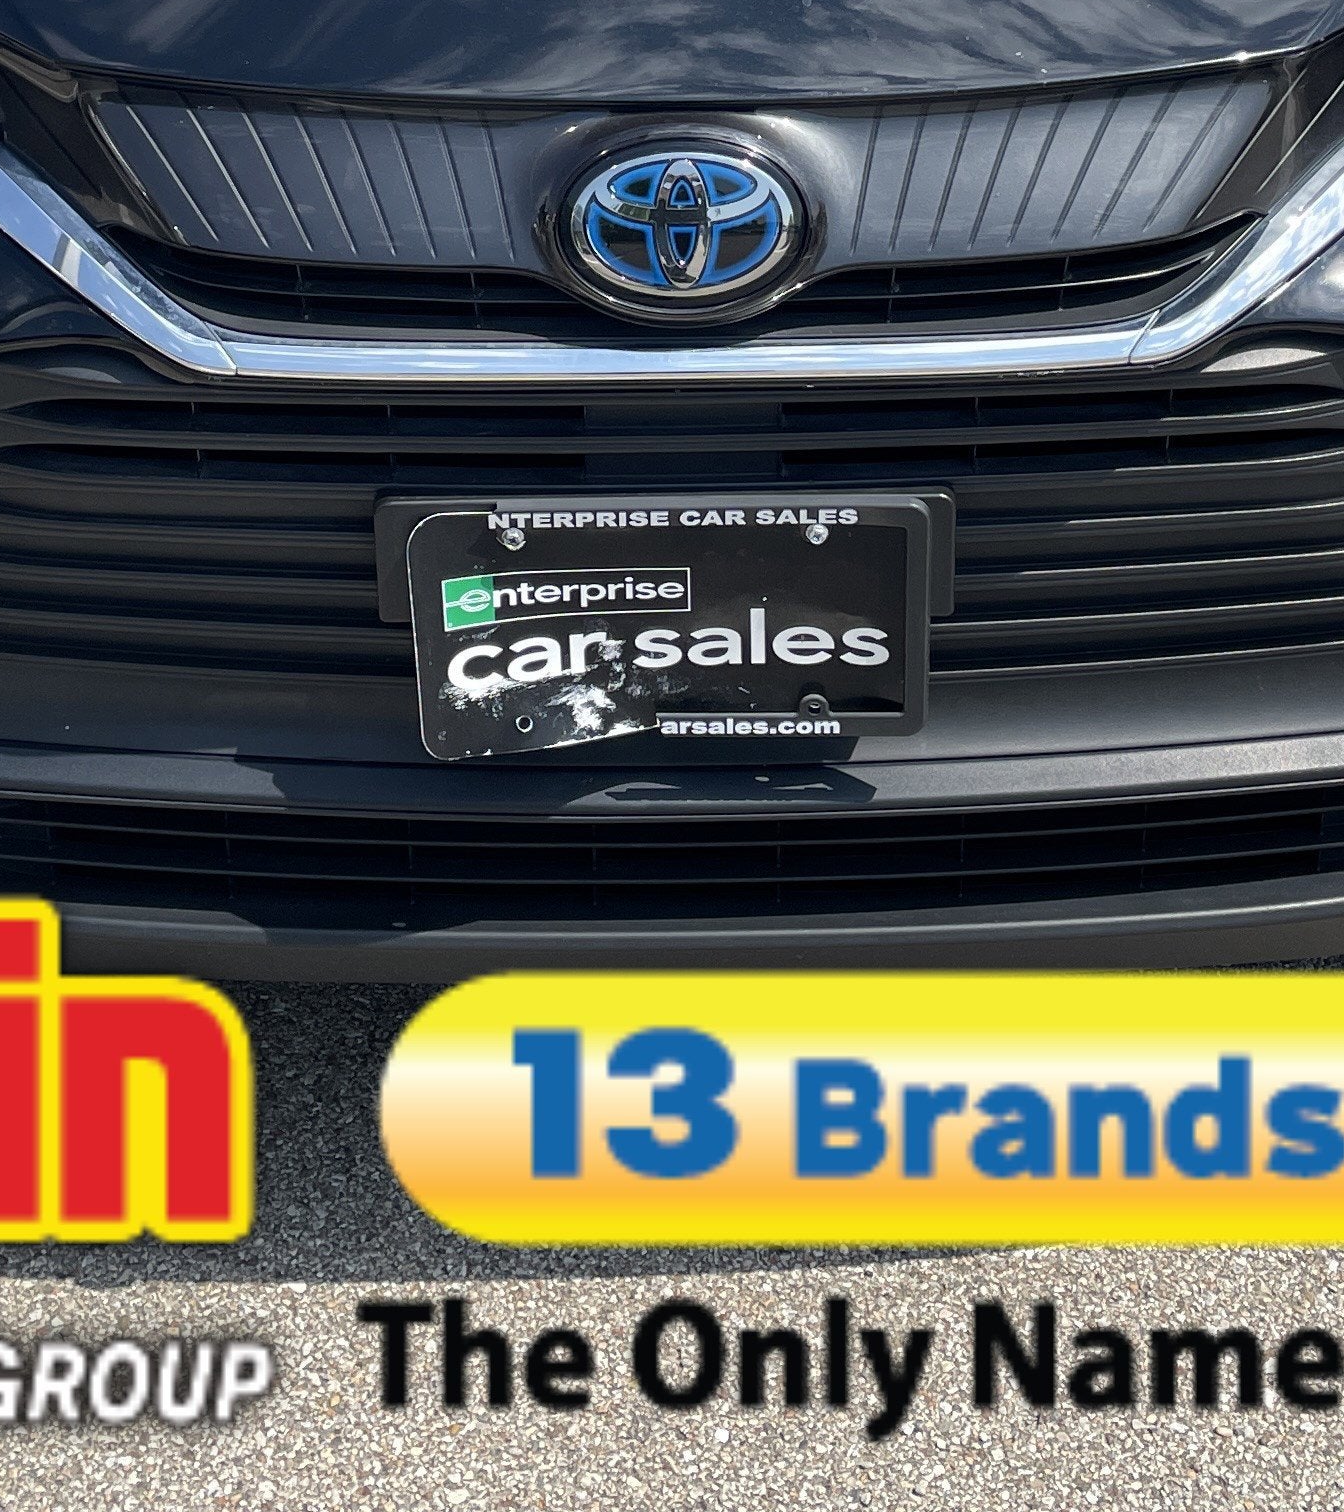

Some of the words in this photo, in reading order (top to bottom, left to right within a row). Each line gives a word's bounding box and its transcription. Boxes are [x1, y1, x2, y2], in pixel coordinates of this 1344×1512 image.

[679, 509, 747, 527] CAR
[755, 507, 859, 526] SALES
[459, 577, 685, 612] enterprise
[447, 630, 608, 690] car
[633, 607, 891, 668] sales
